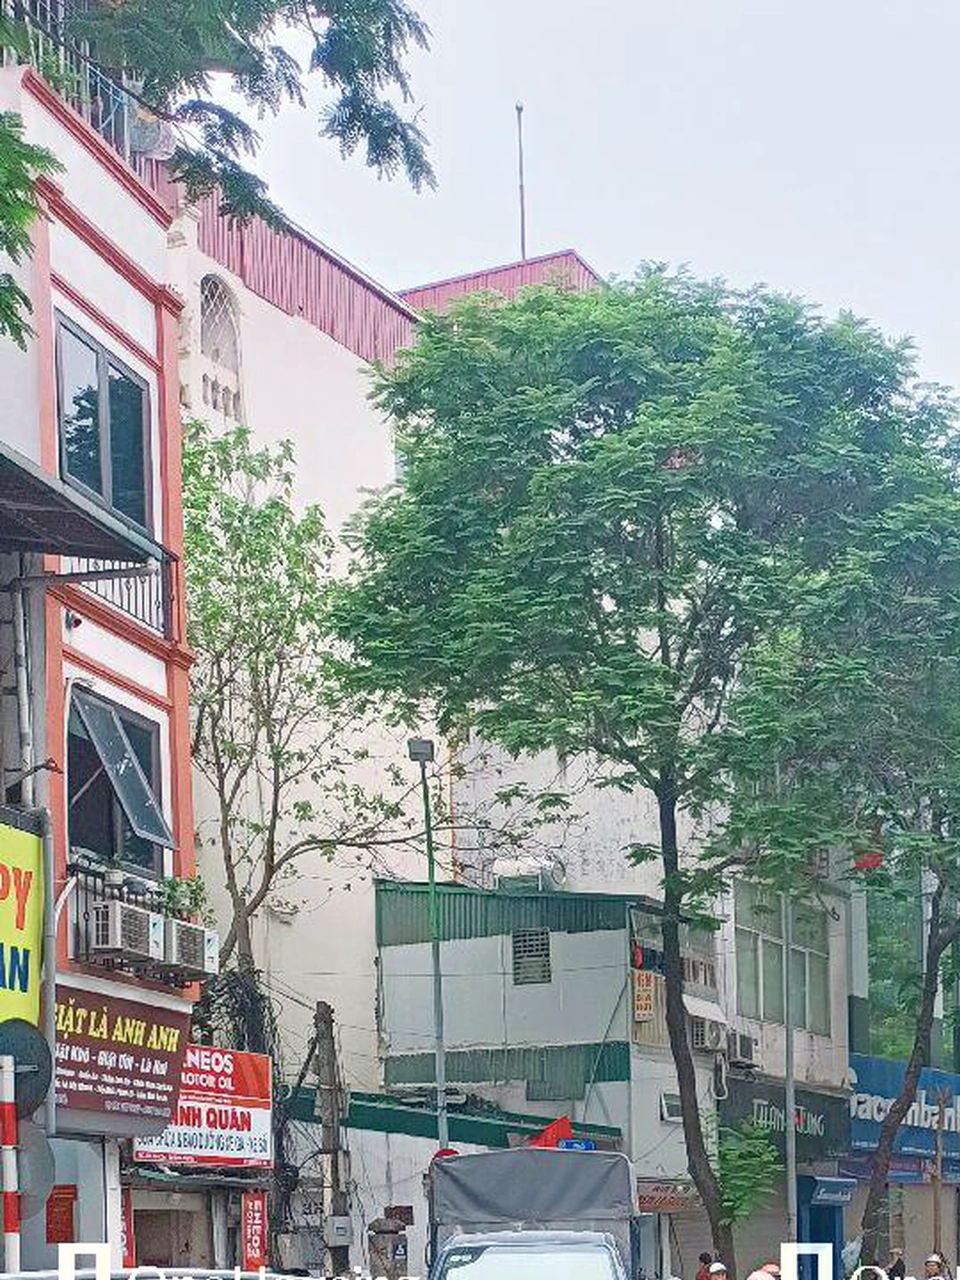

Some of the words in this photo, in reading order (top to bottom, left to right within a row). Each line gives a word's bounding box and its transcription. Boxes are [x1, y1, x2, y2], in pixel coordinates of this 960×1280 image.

[56, 997, 88, 1039] IẶT
[111, 1016, 147, 1046] ANH
[147, 1024, 180, 1053] ANH
[182, 1048, 235, 1075] NEOS
